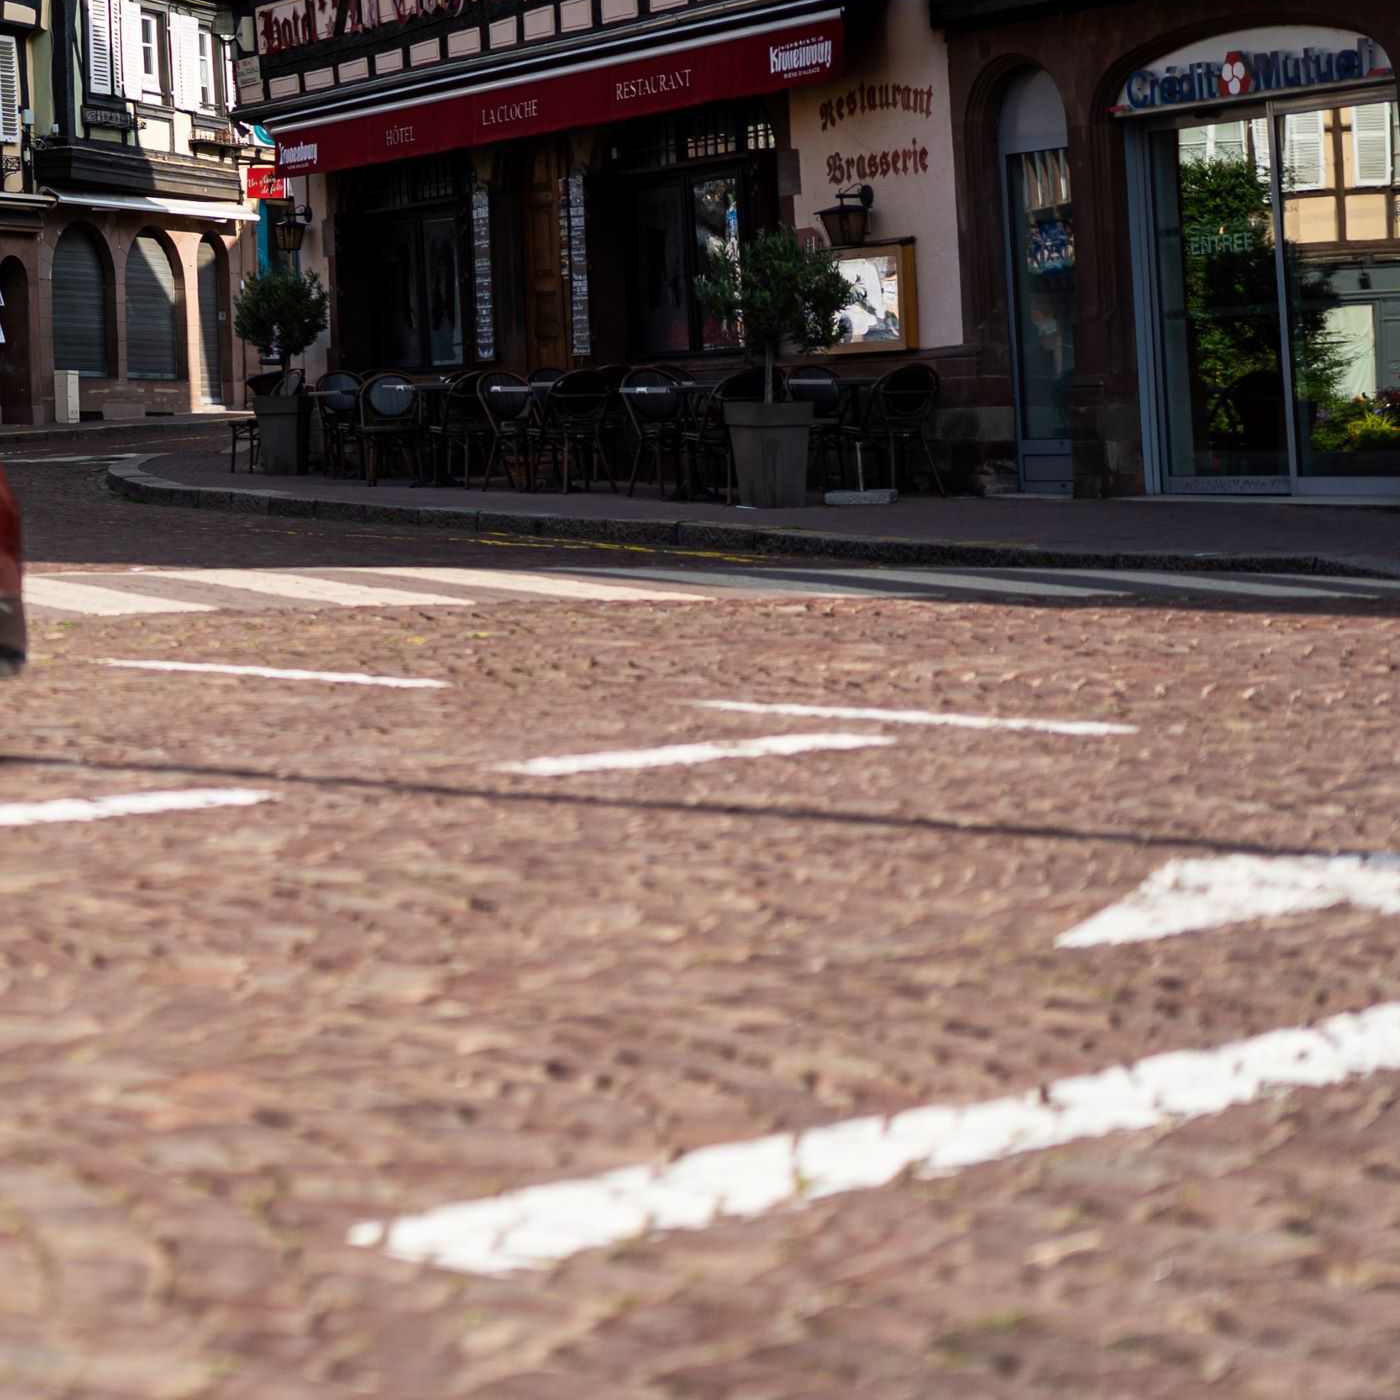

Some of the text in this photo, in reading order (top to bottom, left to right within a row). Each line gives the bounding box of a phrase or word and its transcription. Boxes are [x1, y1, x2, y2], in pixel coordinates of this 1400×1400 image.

[615, 69, 692, 101] RESTAURANT
[1127, 38, 1369, 108] Crédit Mutuel
[482, 99, 538, 126] LA CLOCHE
[819, 81, 933, 133] Restaurant
[826, 137, 929, 184] Brasserie
